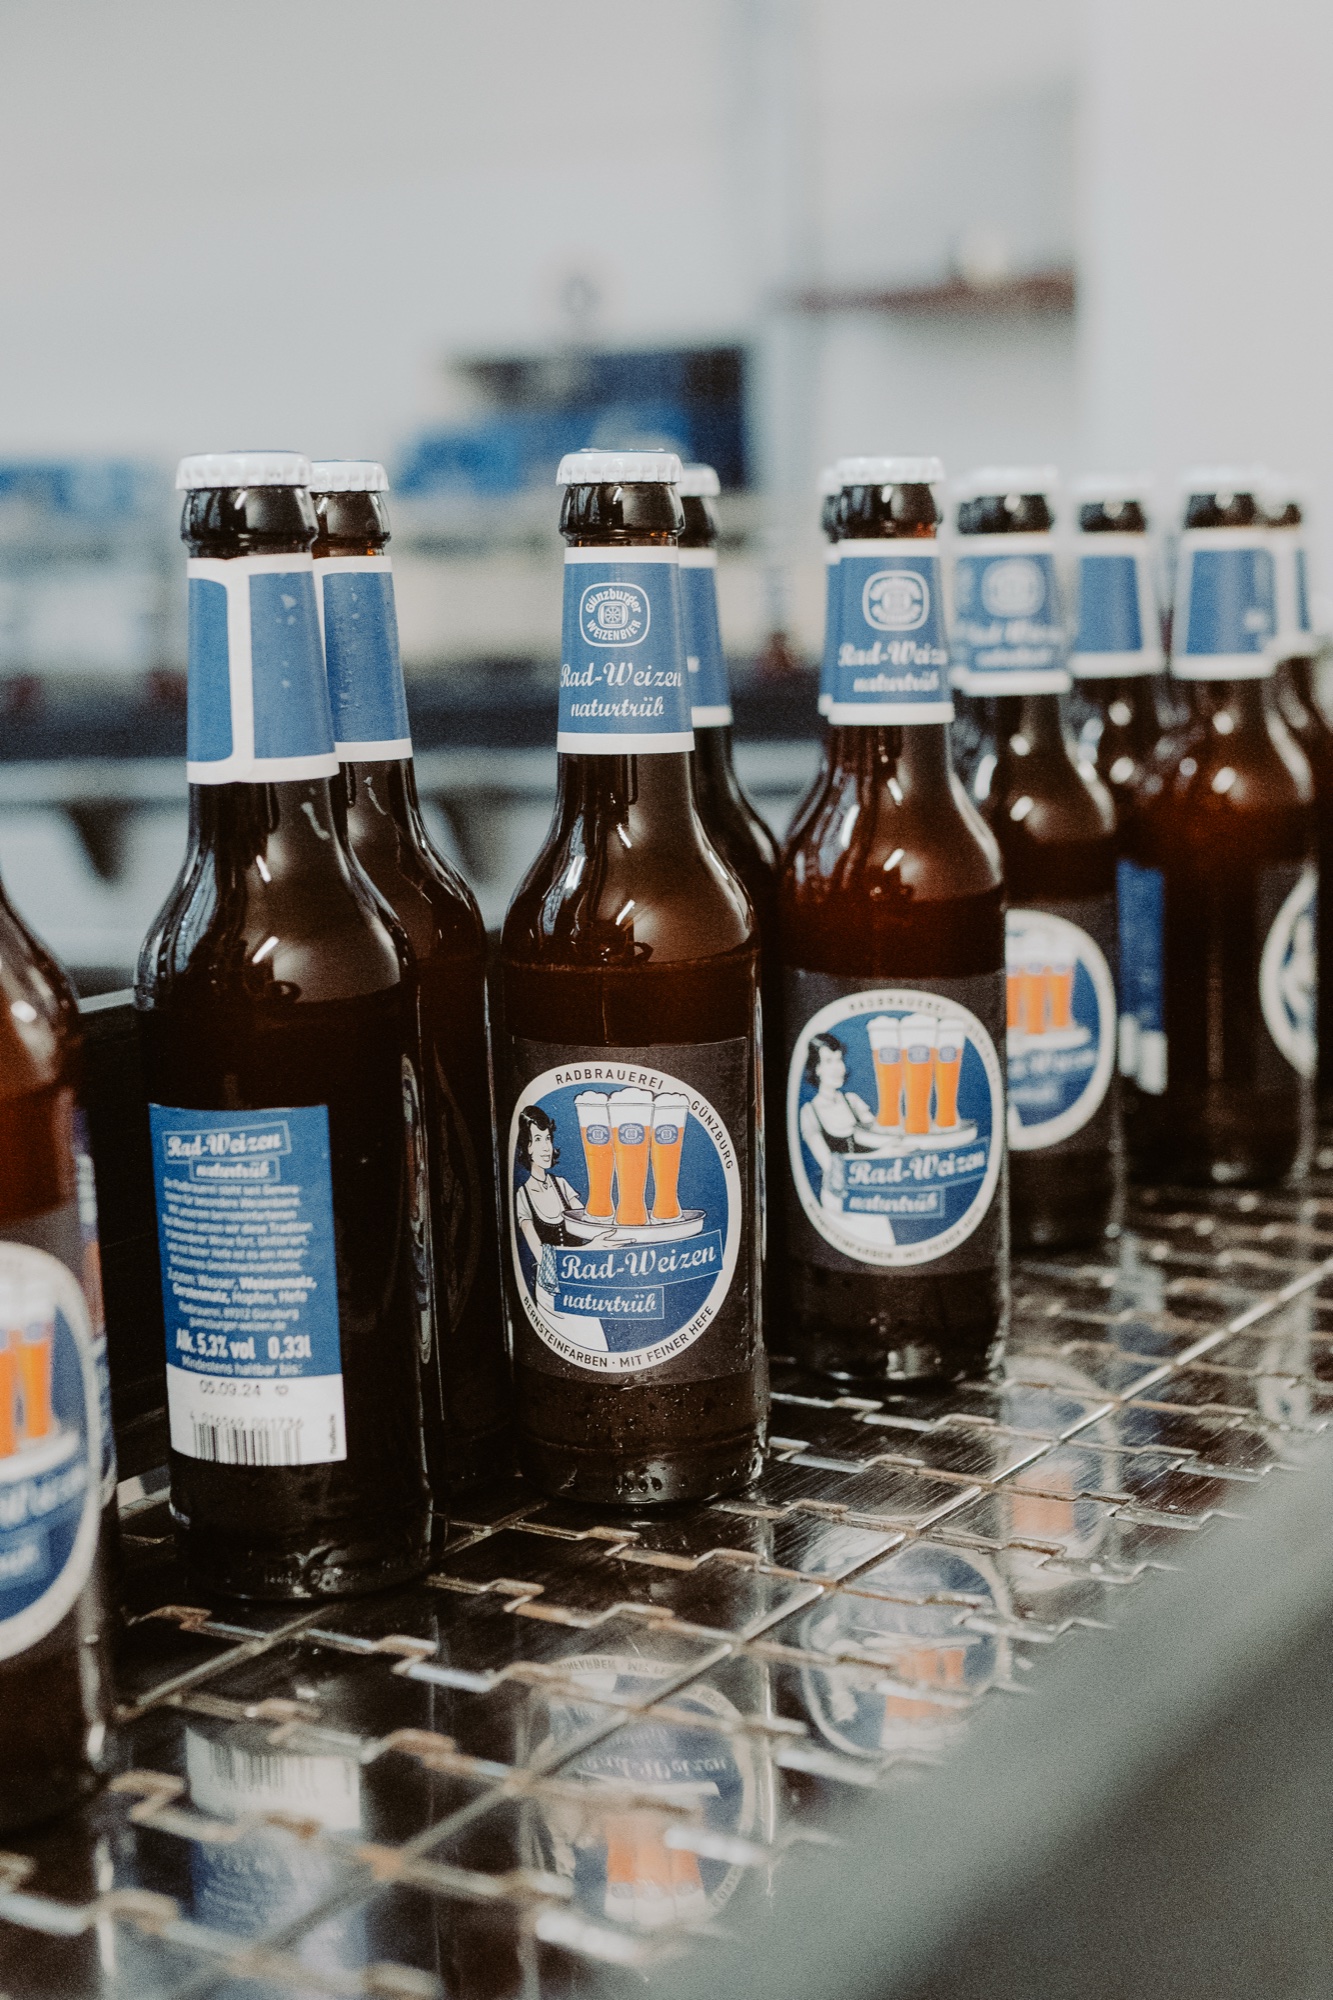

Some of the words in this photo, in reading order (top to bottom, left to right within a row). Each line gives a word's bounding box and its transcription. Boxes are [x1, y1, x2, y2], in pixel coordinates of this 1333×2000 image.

[585, 588, 641, 613] Günzburger
[586, 619, 642, 641] WEIZENBIER
[560, 662, 682, 688] Rad-Weizen
[571, 696, 665, 718] naturtrüb
[555, 1068, 664, 1090] RADBRAUEREI
[691, 1100, 734, 1170] GÜNZBURG
[167, 1132, 282, 1157] Rad-Weizen
[847, 1150, 986, 1185] Rad-Weizen
[561, 1246, 716, 1280] Rad-Weizen
[563, 1293, 657, 1313] naturtrüb
[523, 1296, 608, 1368] BERNSTEINFARBEN
[620, 1354, 643, 1368] MIT
[647, 1333, 689, 1363] FEINER
[689, 1305, 714, 1336] HEFE
[229, 1336, 256, 1360] vol
